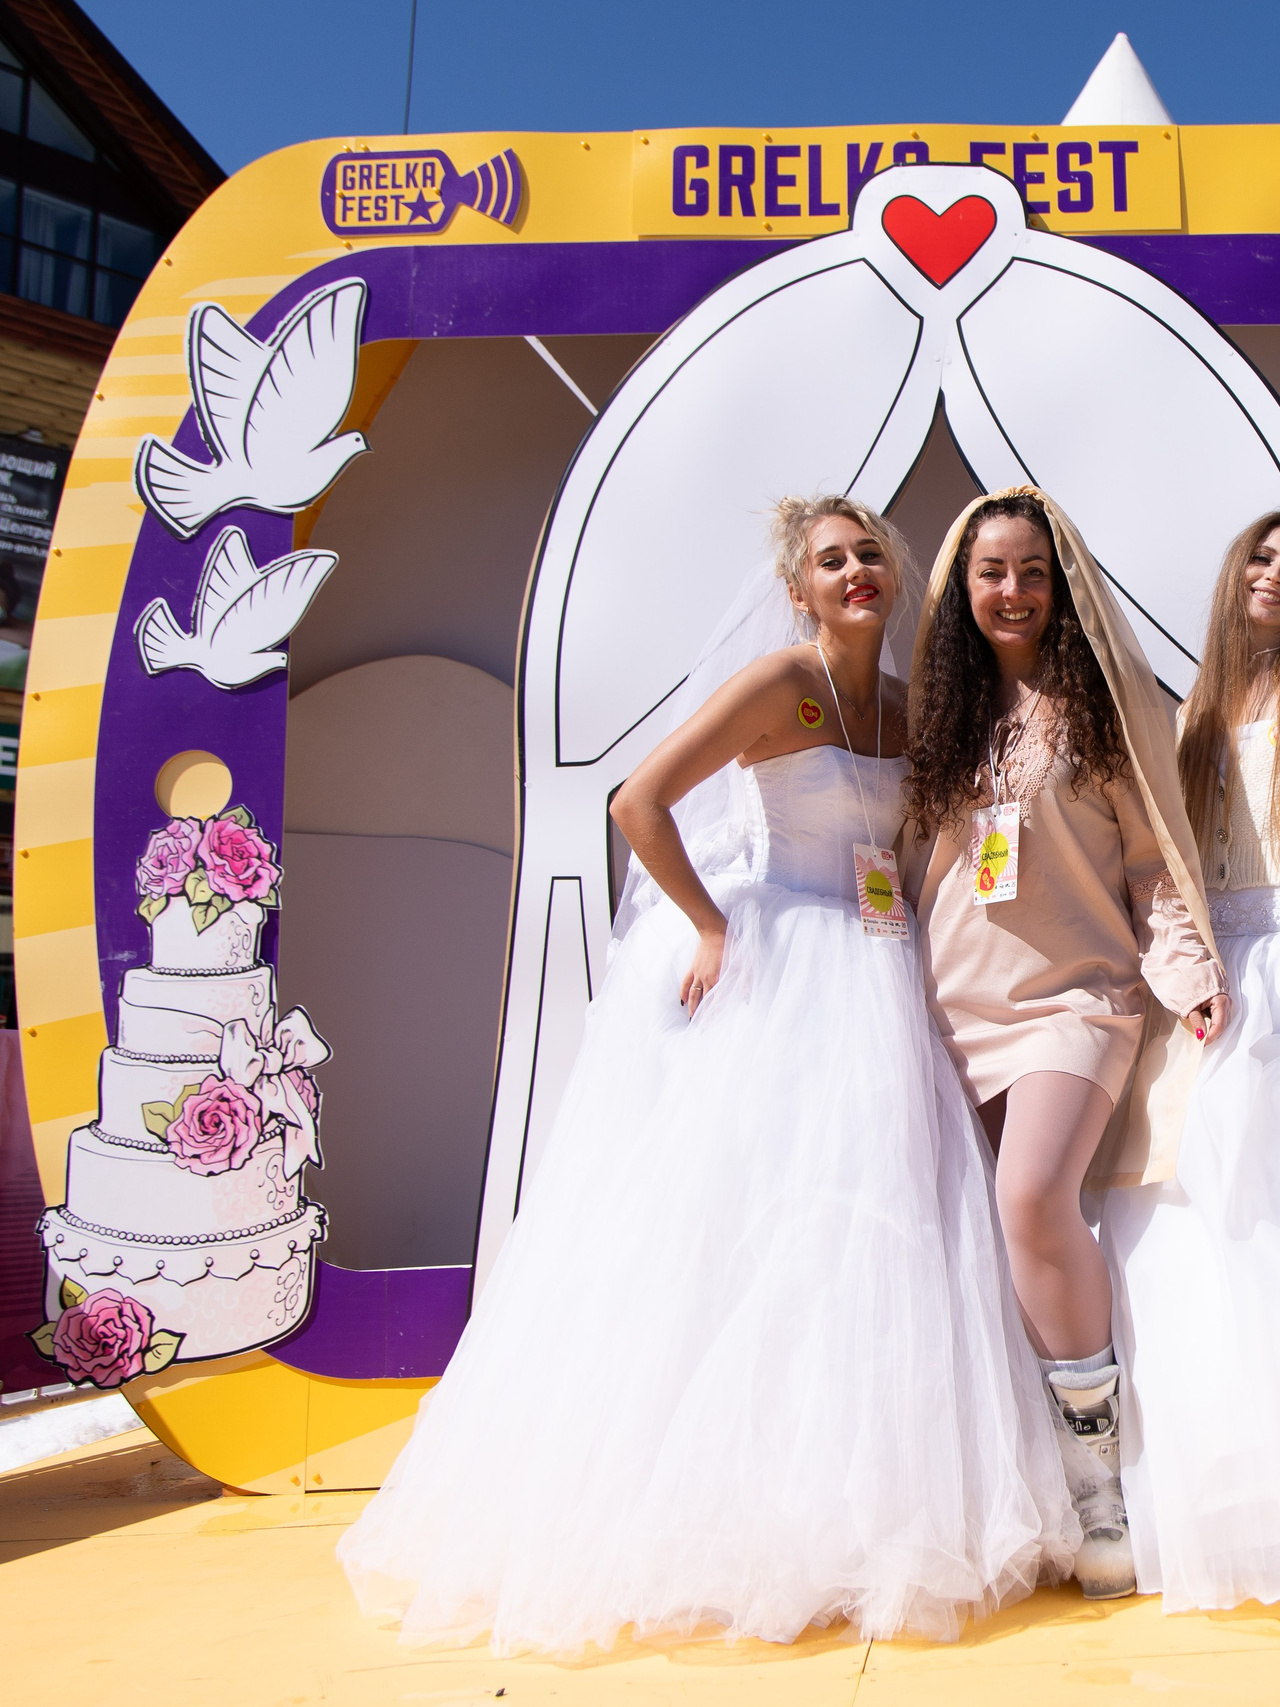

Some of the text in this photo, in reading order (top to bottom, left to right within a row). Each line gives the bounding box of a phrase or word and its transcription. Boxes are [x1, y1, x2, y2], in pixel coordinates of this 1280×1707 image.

[342, 161, 436, 191] GRELKA
[672, 140, 930, 217] GRELK
[341, 194, 405, 222] FEST
